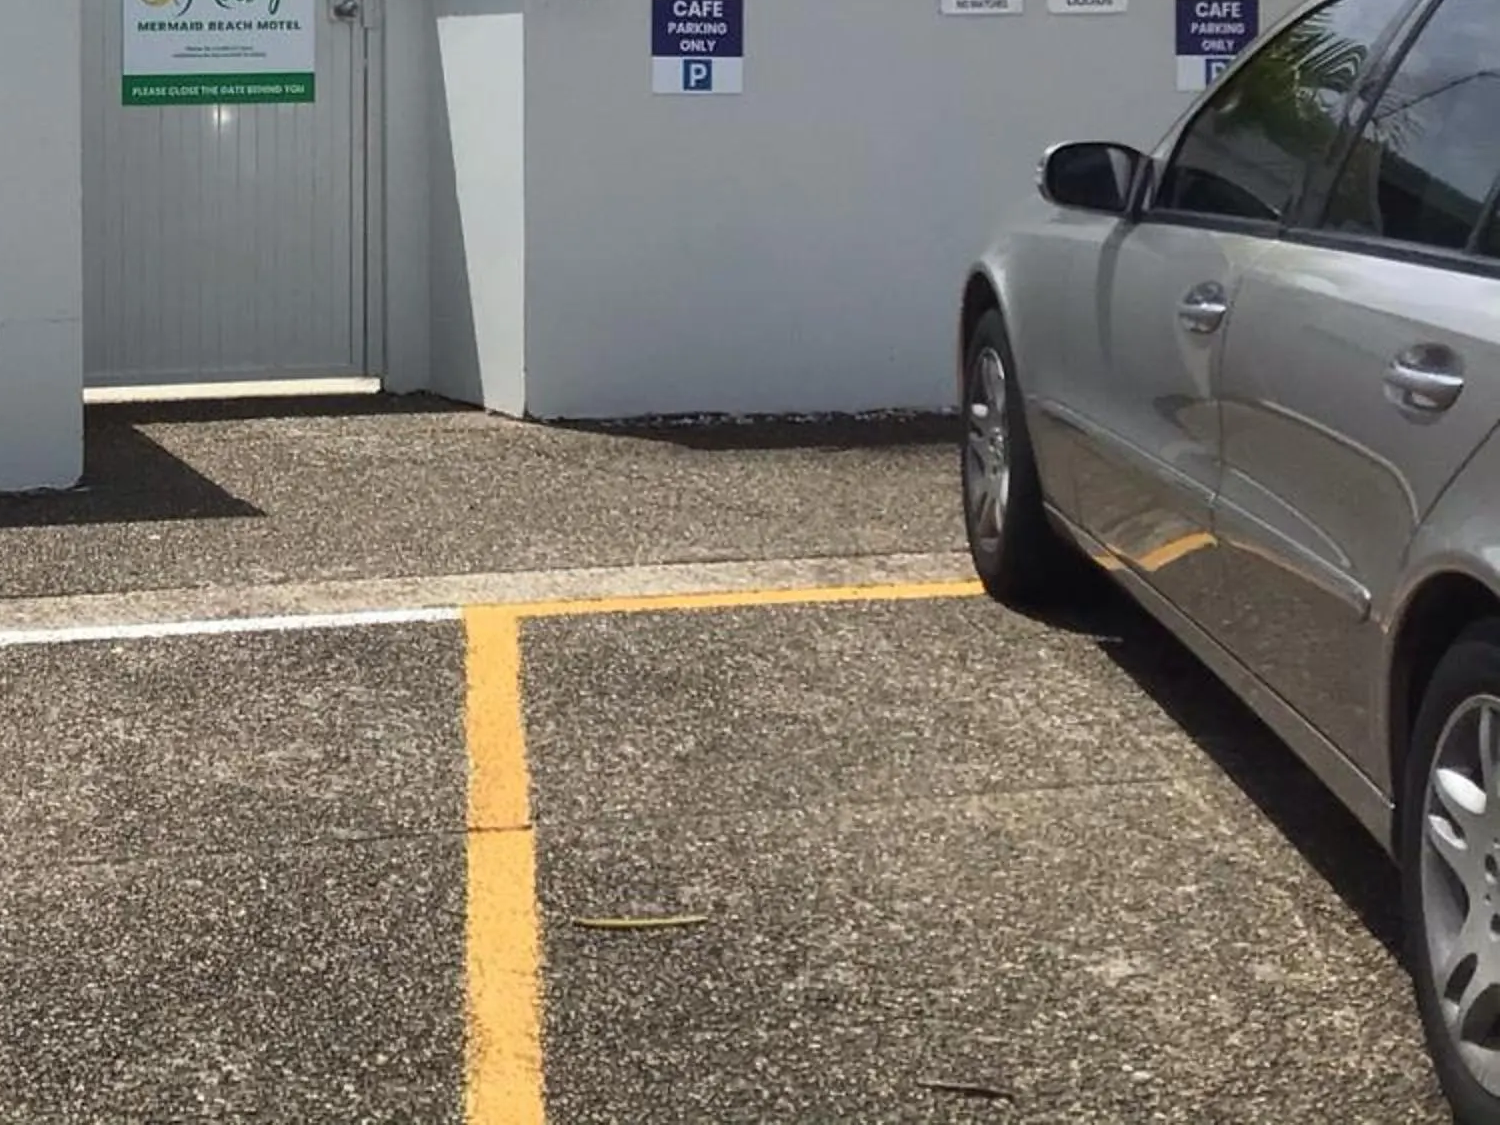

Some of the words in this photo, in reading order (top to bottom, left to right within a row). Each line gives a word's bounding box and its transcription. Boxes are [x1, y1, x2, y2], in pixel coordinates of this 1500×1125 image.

[673, 0, 723, 17] CAFE
[1195, 2, 1242, 17] CAFE
[137, 21, 203, 32] MERMAID
[208, 20, 252, 31] BEACH
[257, 20, 302, 31] MOTEL
[667, 22, 728, 35] PARKING
[1190, 22, 1245, 35] PARKING
[680, 39, 716, 52] ONLY
[1202, 39, 1235, 52] ONLY
[690, 63, 707, 87] P
[132, 87, 166, 96] PLEASE
[168, 87, 198, 96] CLOSE
[201, 86, 218, 95] THE
[220, 86, 244, 94] GATE
[247, 85, 281, 94] BEHIND
[284, 85, 305, 93] YOU
